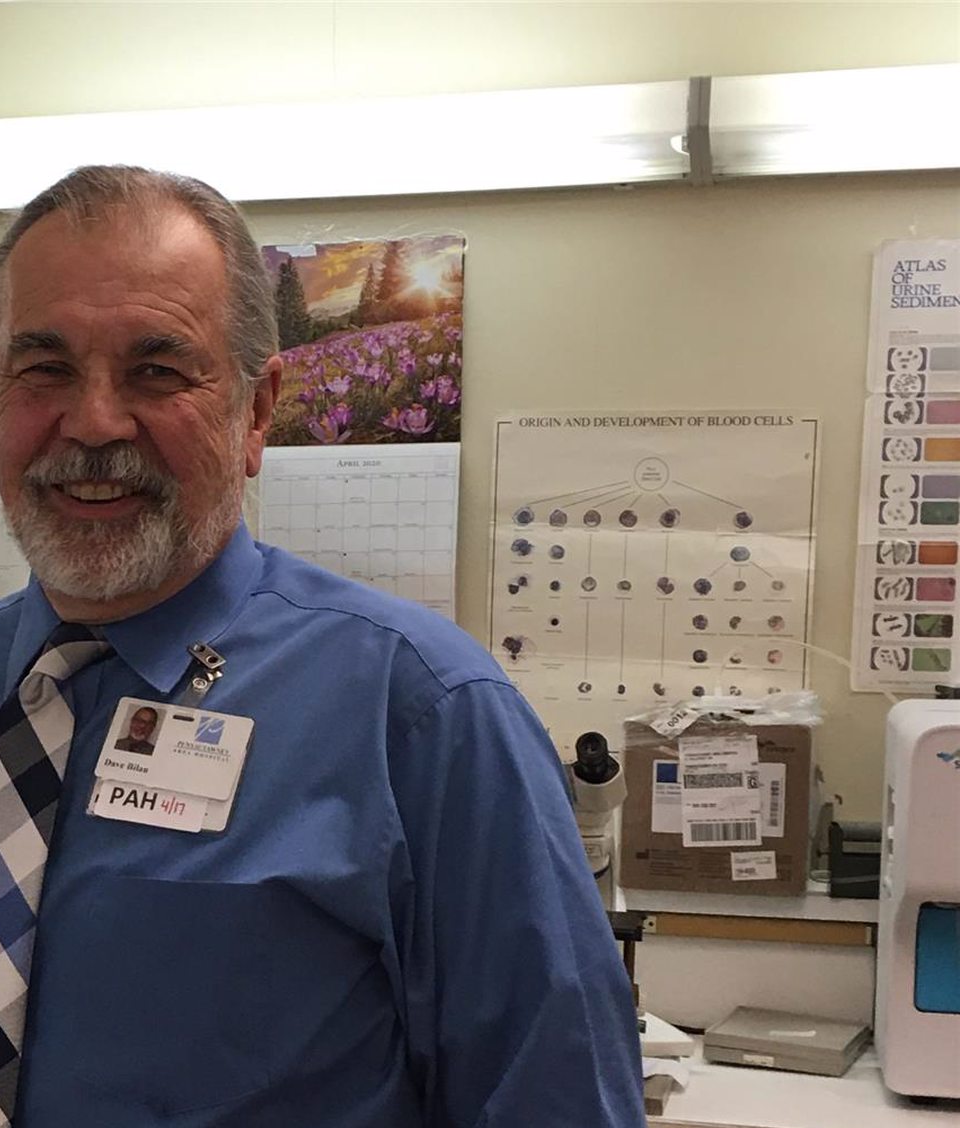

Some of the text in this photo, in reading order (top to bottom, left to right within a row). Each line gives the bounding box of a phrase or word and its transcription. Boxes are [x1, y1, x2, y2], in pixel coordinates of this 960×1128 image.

[893, 259, 947, 273] ATLAS
[890, 272, 914, 285] OF
[891, 284, 942, 296] URINE
[518, 415, 794, 428] ORIGIN AND DEVELOPMENT OF BLOOD CELLS
[104, 757, 125, 769] Dave
[109, 786, 159, 811] PAH
[160, 795, 186, 816] 4/17
